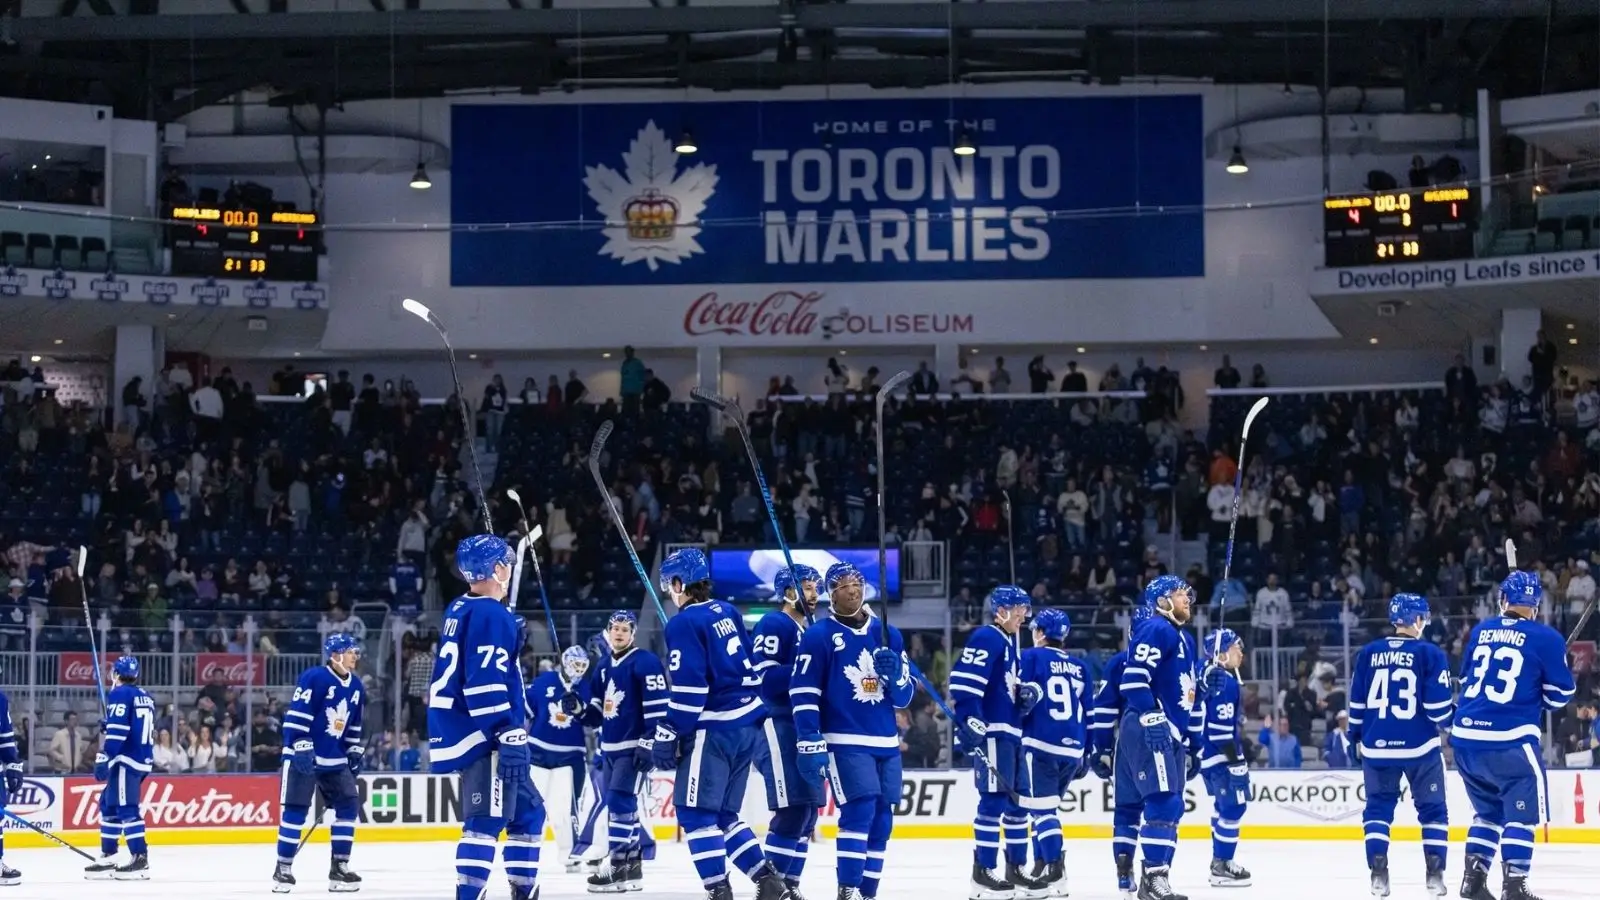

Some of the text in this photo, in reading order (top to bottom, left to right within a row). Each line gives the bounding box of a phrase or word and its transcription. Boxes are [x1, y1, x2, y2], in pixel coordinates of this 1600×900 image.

[813, 119, 997, 134] HOME OF THE
[752, 144, 1062, 204] TORONTO
[224, 211, 258, 226] 00.0
[1348, 203, 1458, 224] 4 1
[765, 206, 1051, 264] MARLIES
[1338, 265, 1456, 290] Developing
[1464, 260, 1521, 281] Leafs
[1529, 254, 1585, 276] since
[684, 290, 973, 337] Coca-Cola COLISEUM
[1525, 586, 1534, 595] 33
[752, 634, 779, 655] 29
[1478, 629, 1527, 651] BENNING
[477, 645, 509, 673] 72
[669, 650, 681, 671] 3
[961, 647, 988, 667] 52
[1135, 643, 1162, 668] 92
[1371, 656, 1414, 671] HAYMES
[1050, 660, 1083, 679] SHARPE
[1464, 645, 1524, 705] 33
[646, 674, 666, 694] 59
[1367, 668, 1417, 720] 43
[293, 687, 313, 704] 64
[350, 690, 360, 705] A
[1046, 673, 1085, 724] 97
[106, 703, 126, 718] 76
[1216, 703, 1234, 721] 39
[970, 721, 987, 733] CC
[505, 733, 527, 745] CC
[798, 744, 826, 752] CCM
[1249, 784, 1350, 803] JACKPOT
[70, 781, 272, 829] Ti Hortons
